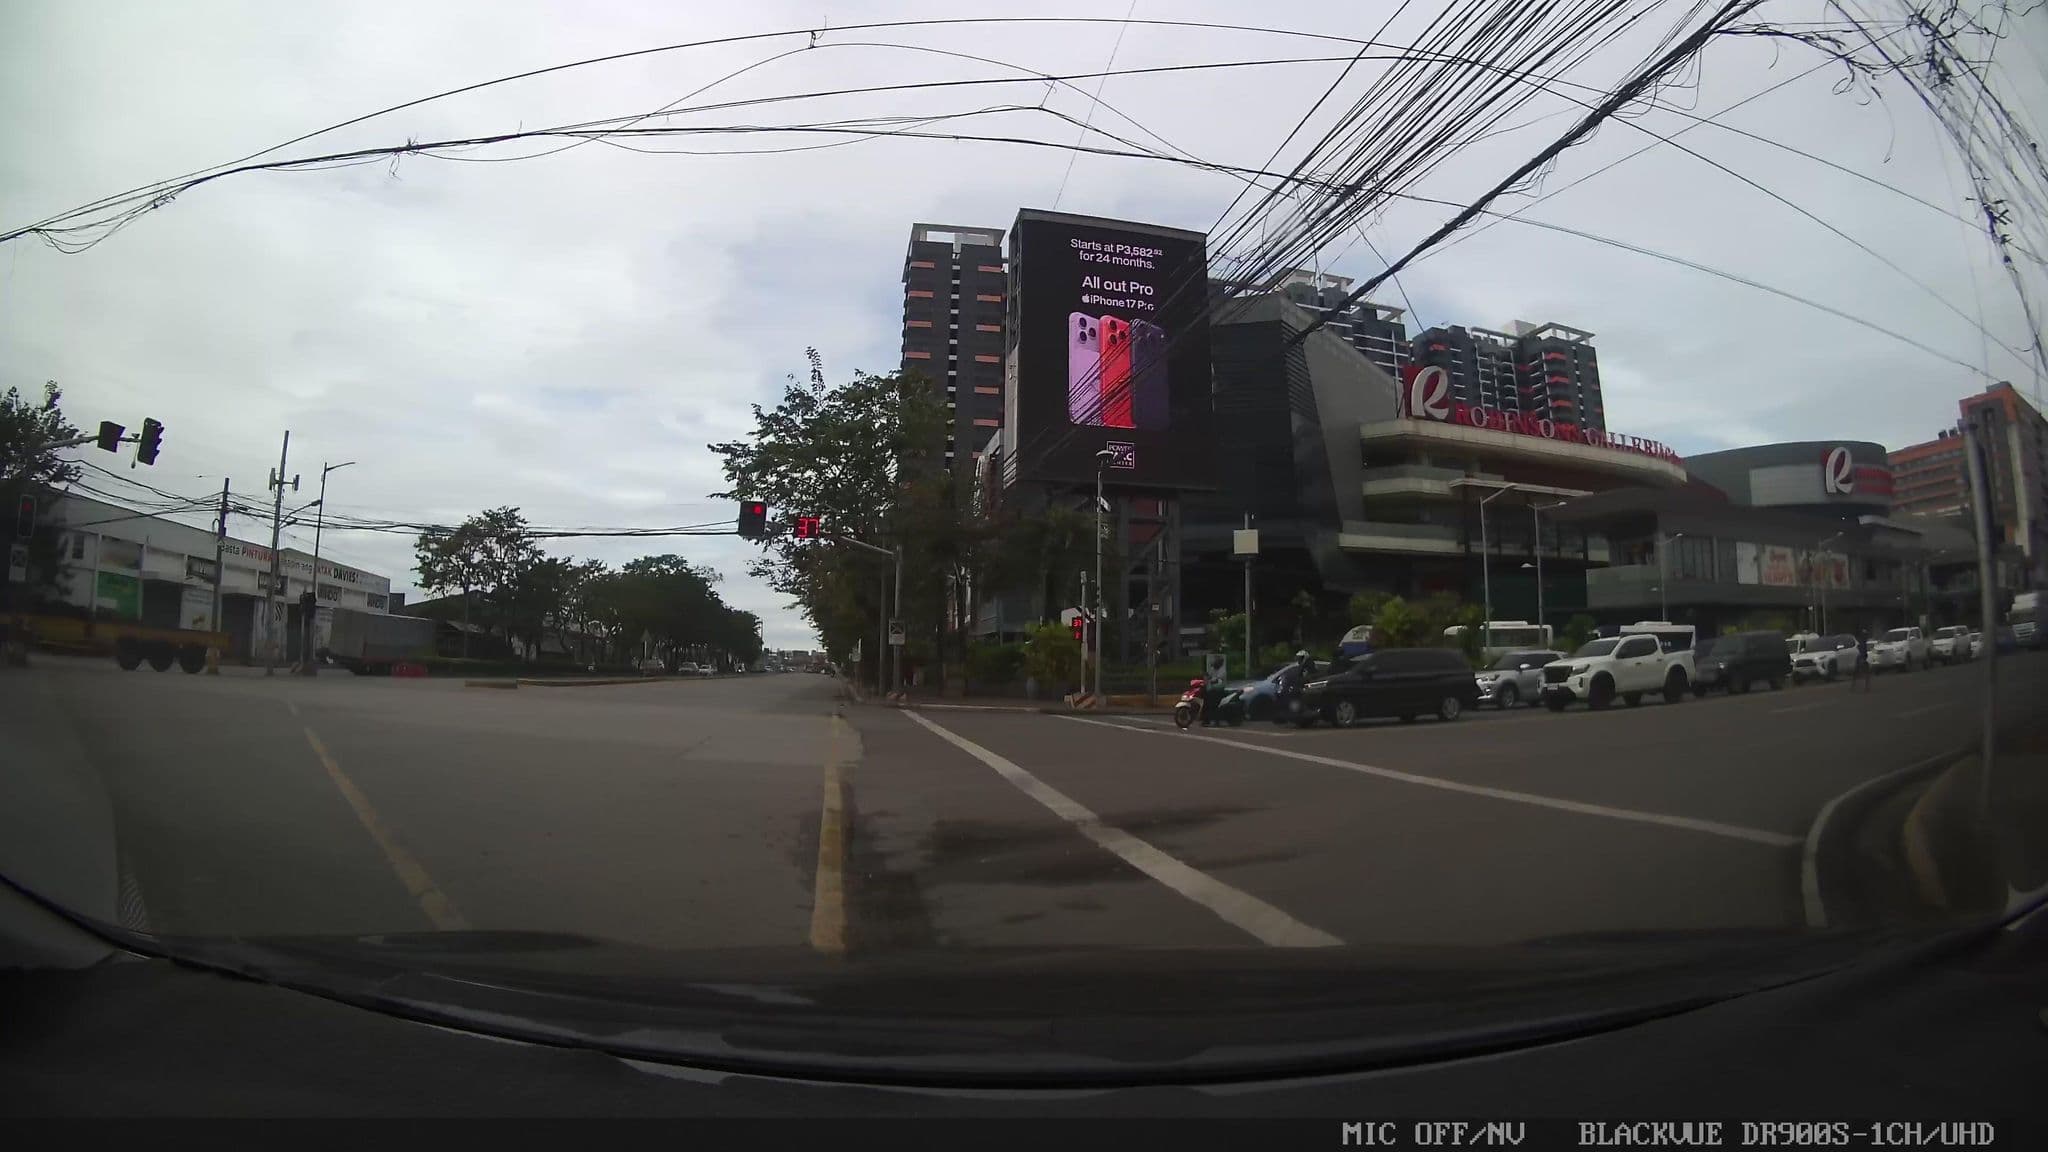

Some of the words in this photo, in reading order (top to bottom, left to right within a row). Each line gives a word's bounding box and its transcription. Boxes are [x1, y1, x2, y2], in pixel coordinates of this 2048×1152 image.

[1070, 238, 1102, 251] Starts
[1104, 244, 1114, 253] at
[1079, 250, 1096, 261] for
[1096, 254, 1110, 264] 24
[1112, 256, 1155, 270] months.
[1082, 276, 1100, 289] All
[1104, 280, 1127, 292] out
[1130, 281, 1154, 296] Pro
[1090, 294, 1125, 308] iPhone
[1126, 299, 1137, 309] 17
[798, 518, 819, 538] 37
